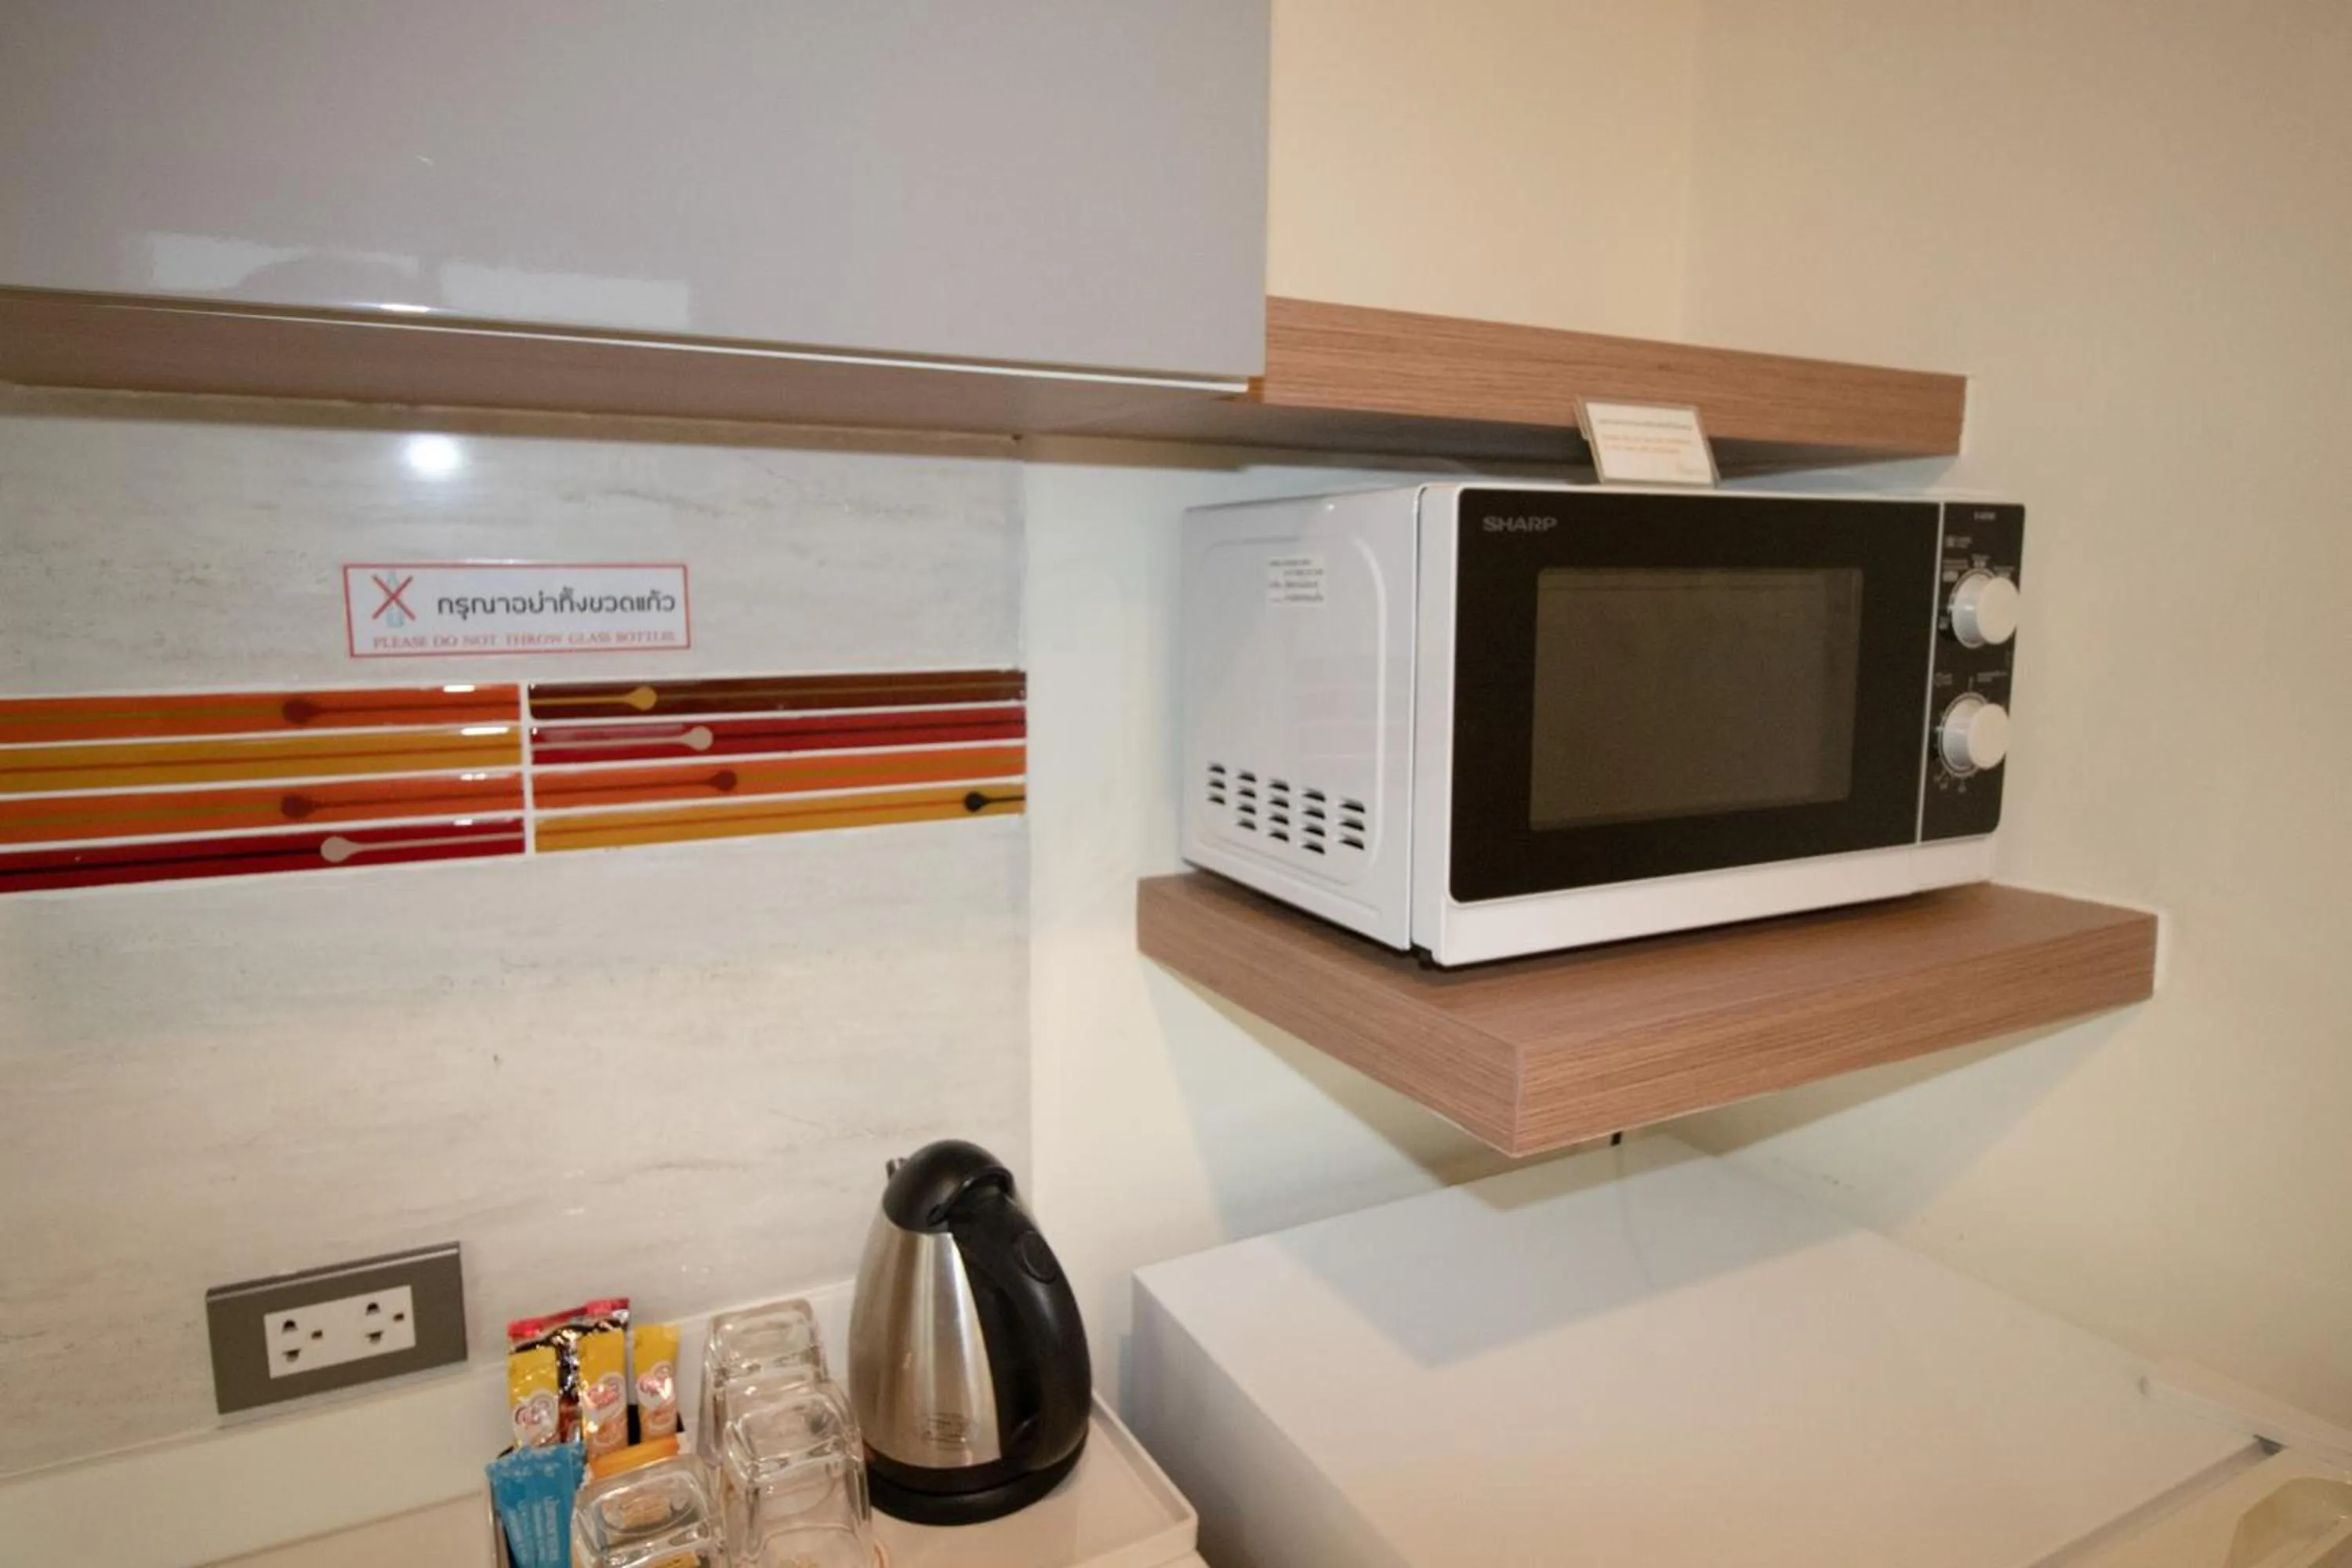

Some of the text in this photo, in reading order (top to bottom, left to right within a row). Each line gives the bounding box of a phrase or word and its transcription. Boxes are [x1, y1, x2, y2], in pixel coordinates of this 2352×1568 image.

[1483, 516, 1558, 532] SHARP
[437, 586, 675, 621] กรุณาอย่าทิ้งขวดแก้ว
[373, 635, 426, 648] PLEASE
[433, 634, 458, 648] DO
[463, 633, 497, 647] NOT
[506, 632, 563, 645] THROW
[568, 631, 612, 644] GLASS
